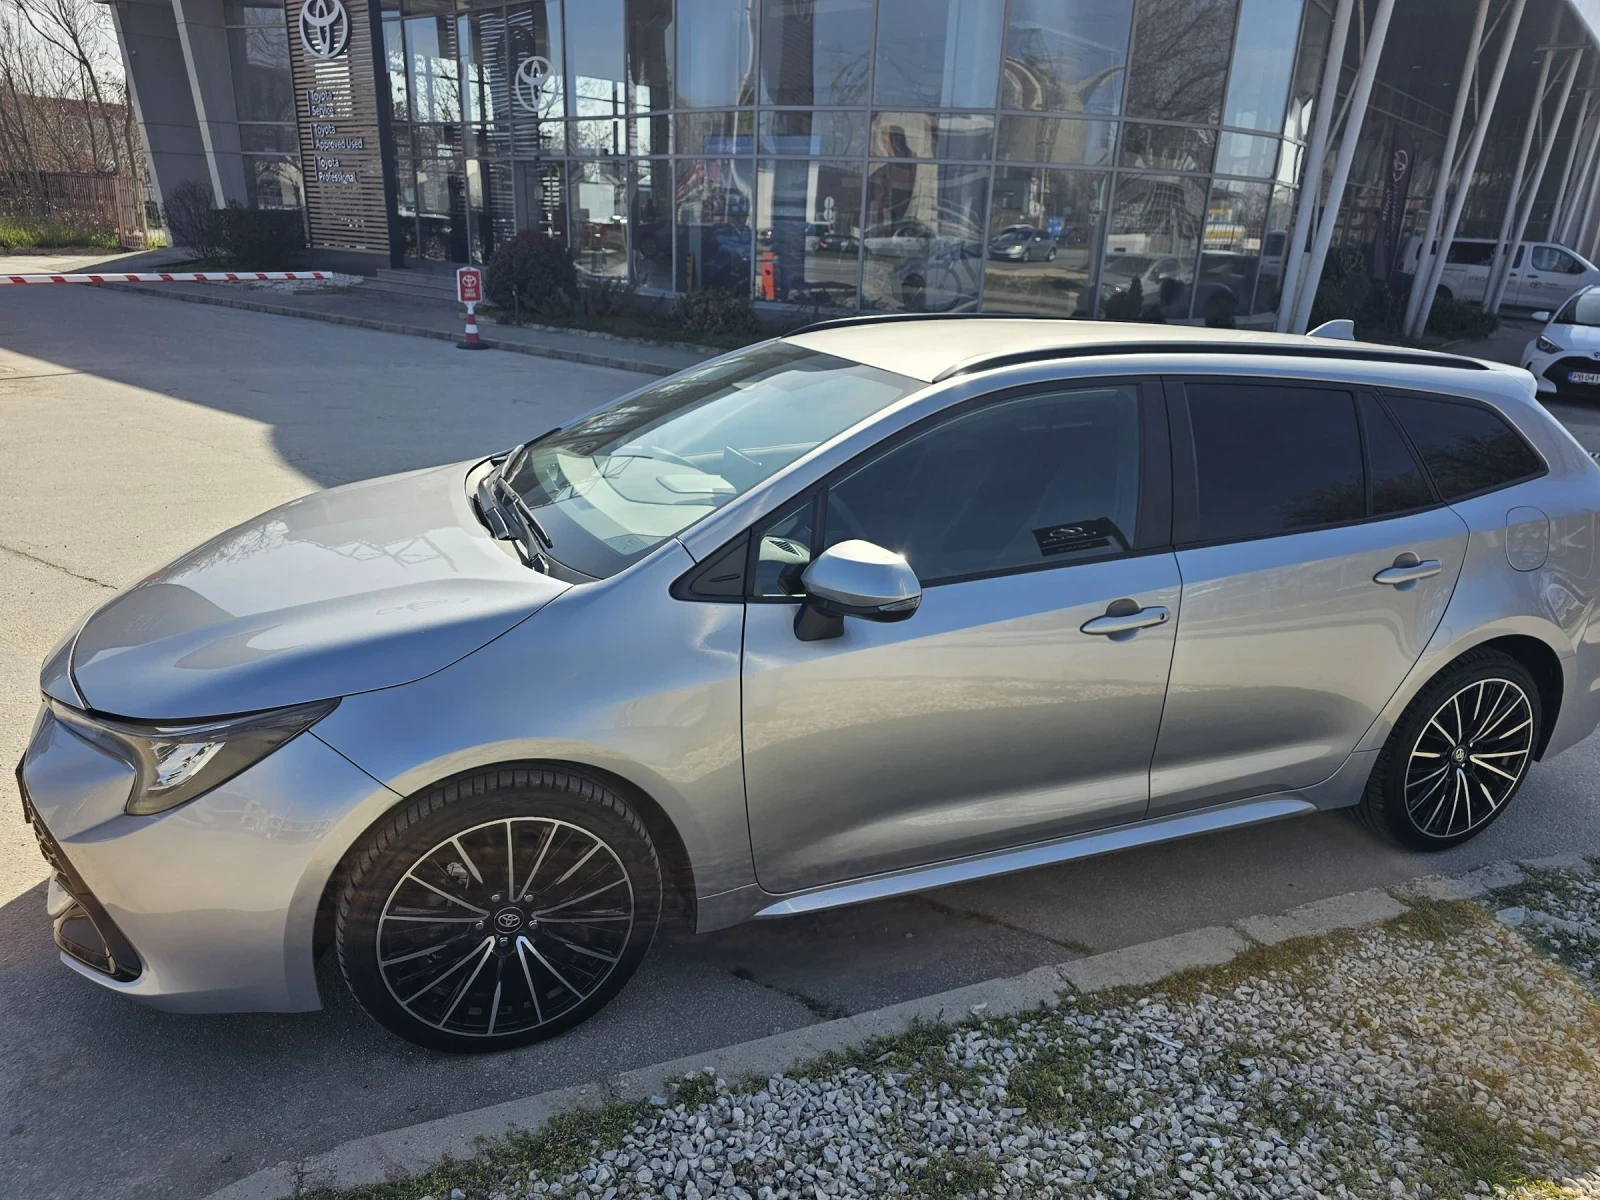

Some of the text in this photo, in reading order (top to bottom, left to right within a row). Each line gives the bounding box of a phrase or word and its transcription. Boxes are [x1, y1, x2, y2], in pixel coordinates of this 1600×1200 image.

[310, 90, 333, 103] Toyota
[312, 106, 334, 116] Service
[314, 124, 336, 136] Toyota
[316, 138, 363, 151] Approved Used
[318, 157, 339, 169] Toyota
[319, 172, 357, 183] Professional
